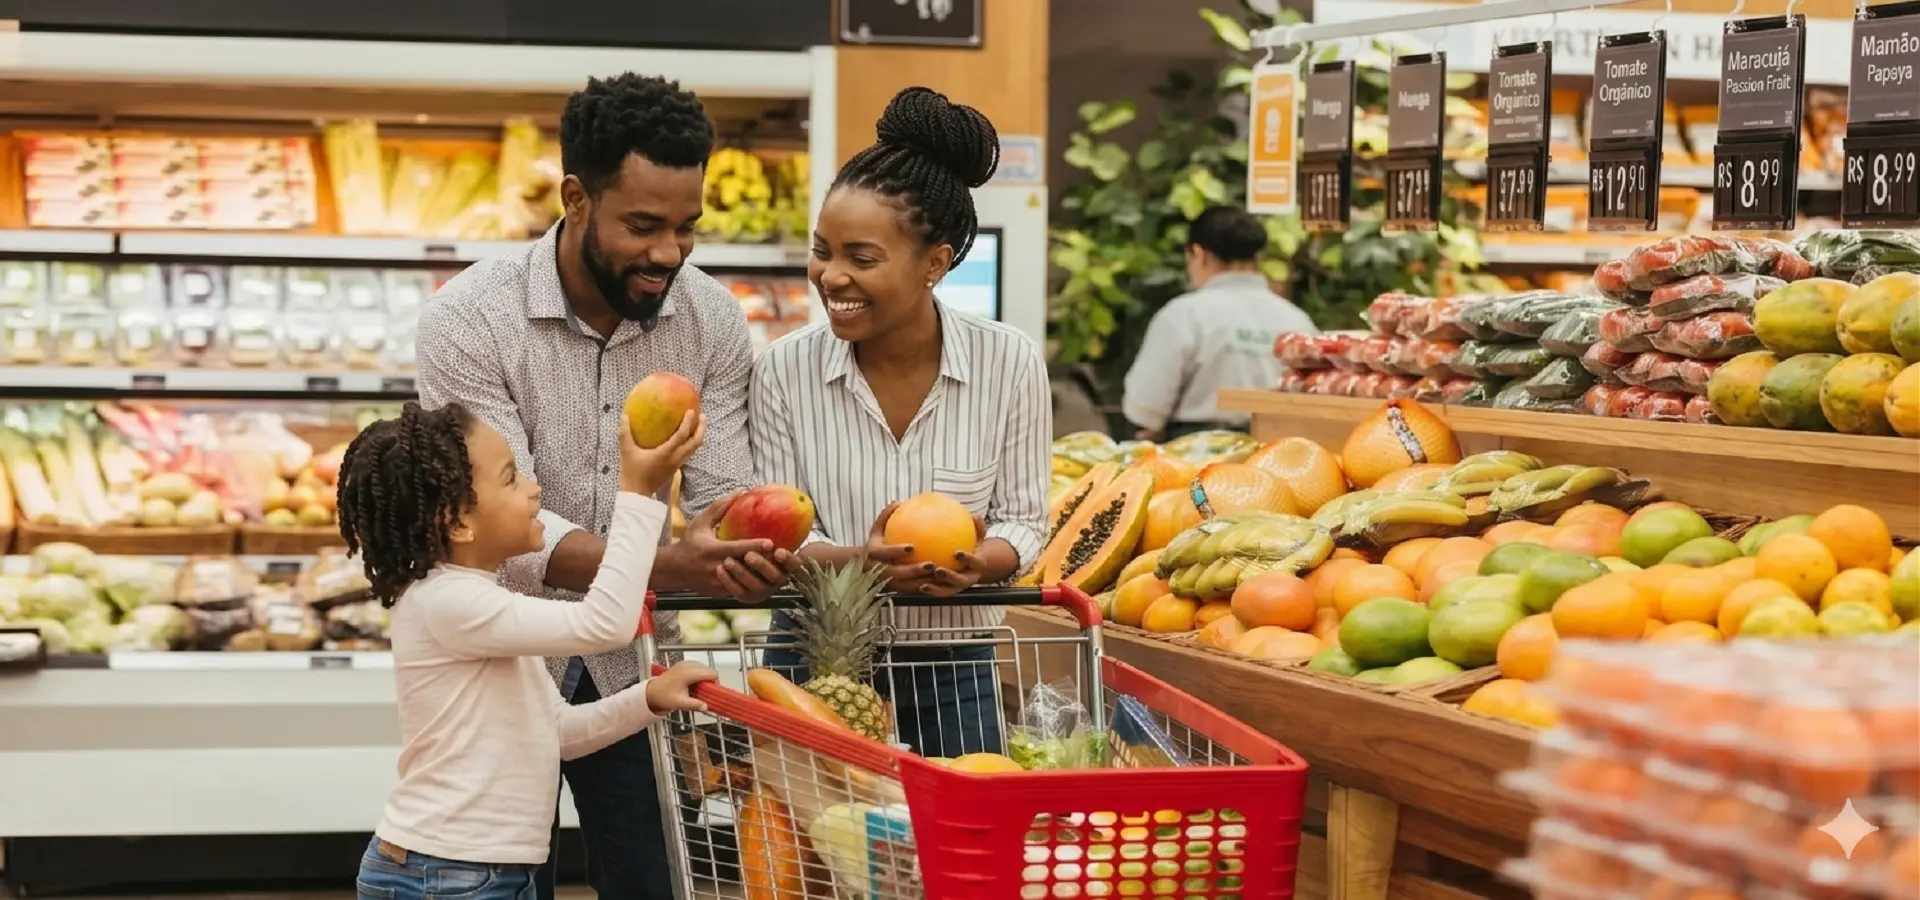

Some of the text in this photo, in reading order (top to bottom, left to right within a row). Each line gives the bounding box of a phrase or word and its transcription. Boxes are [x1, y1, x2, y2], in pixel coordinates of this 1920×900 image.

[1861, 32, 1919, 57] Mamão
[1604, 59, 1648, 79] Tomate
[1728, 44, 1790, 71] Maracujá
[1726, 77, 1764, 93] Passion
[1867, 64, 1912, 86] Papaya
[1848, 156, 1864, 185] R$
